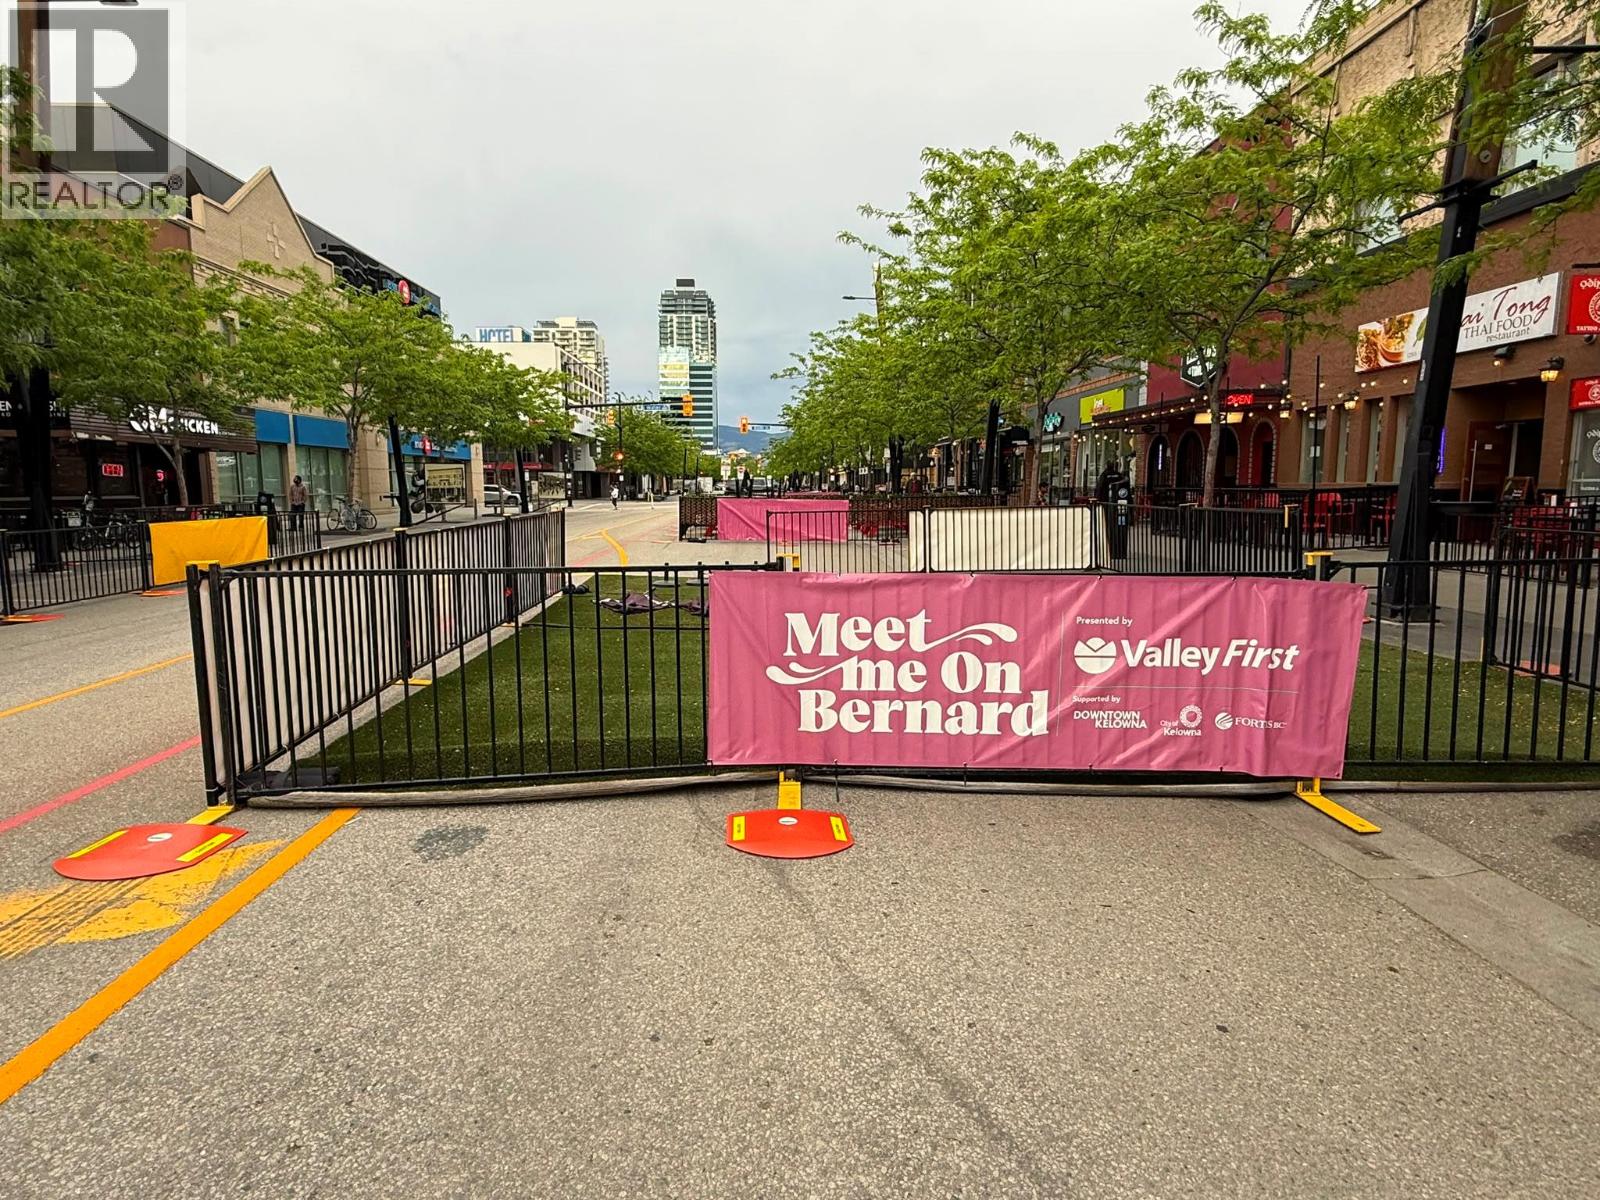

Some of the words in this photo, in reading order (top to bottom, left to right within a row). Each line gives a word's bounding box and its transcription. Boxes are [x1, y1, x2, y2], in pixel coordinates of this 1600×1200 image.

[1461, 302, 1485, 327] ai
[1493, 286, 1551, 325] Tong
[1464, 322, 1492, 339] THAI
[1496, 314, 1533, 333] FOOD
[1486, 327, 1530, 342] restaurant
[1227, 394, 1252, 405] OPEN
[1076, 616, 1118, 625] Presented
[1121, 616, 1133, 627] by
[783, 608, 1018, 656] Meet
[1121, 638, 1221, 676] Valley
[1222, 639, 1300, 671] First
[766, 655, 927, 692] me
[941, 651, 1022, 693] On
[1072, 695, 1109, 704] Supported
[1111, 695, 1121, 704] by
[797, 690, 1049, 737] Bernard
[1073, 710, 1140, 720] DOWNTOWN
[1095, 719, 1147, 729] KELOWNA
[1160, 720, 1172, 729] City
[1163, 728, 1202, 736] Kelowna
